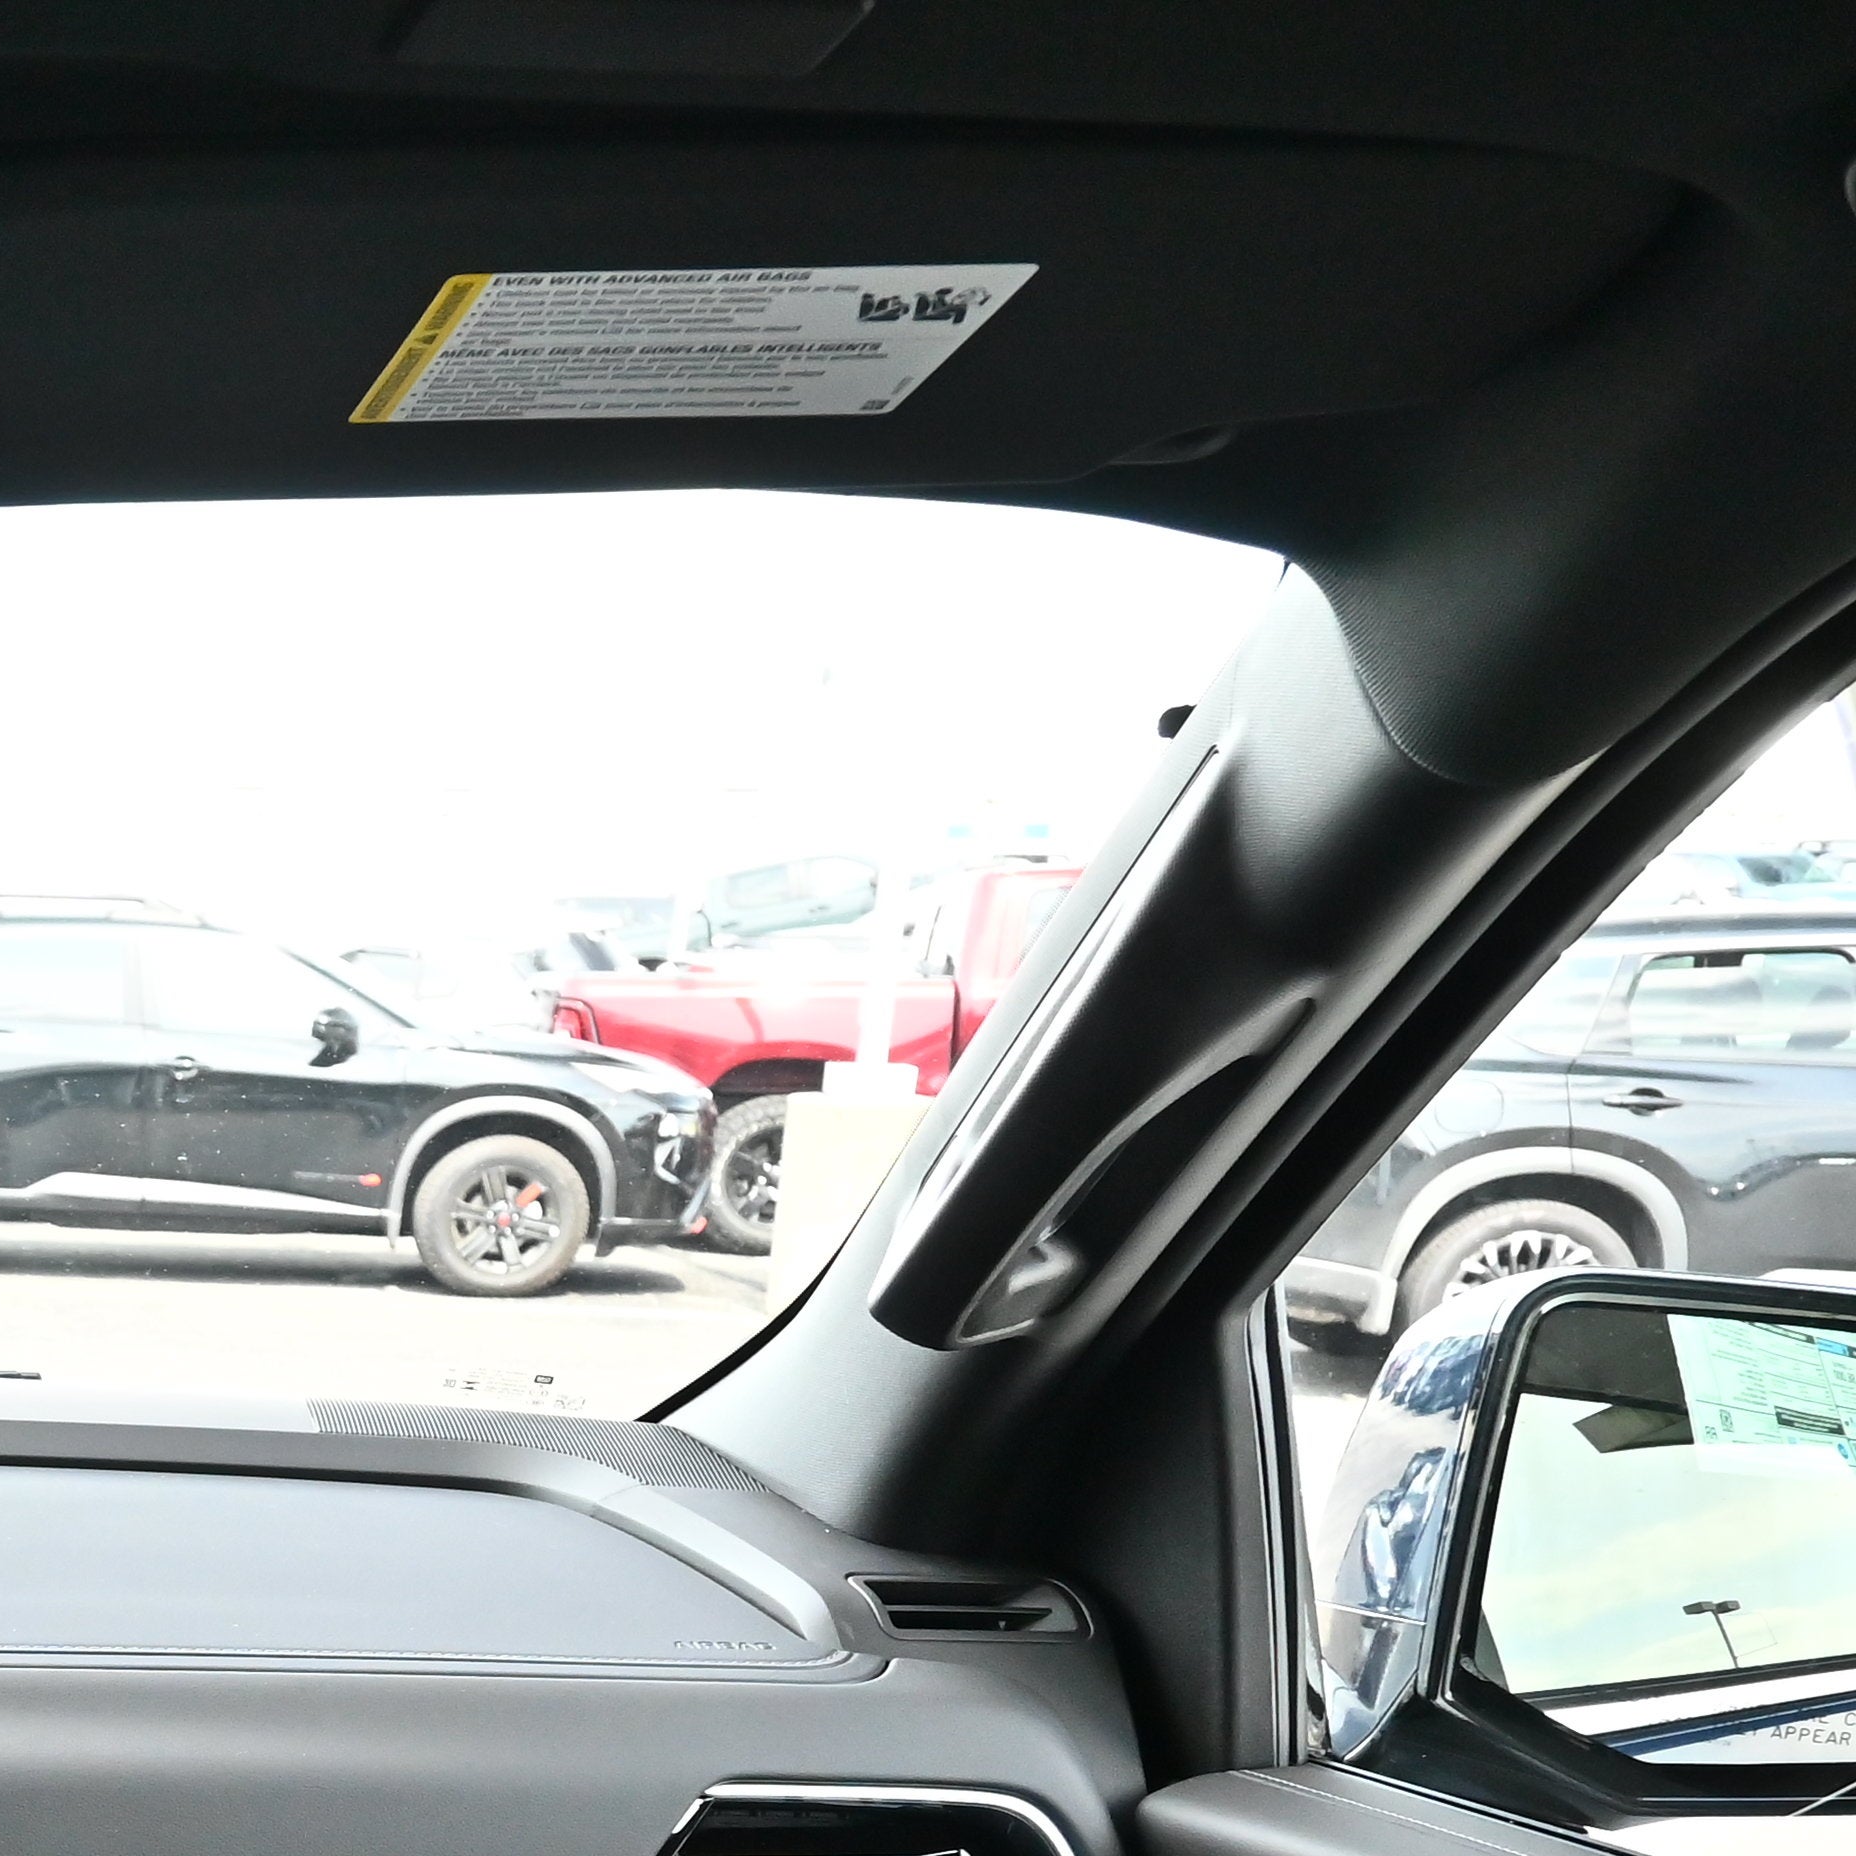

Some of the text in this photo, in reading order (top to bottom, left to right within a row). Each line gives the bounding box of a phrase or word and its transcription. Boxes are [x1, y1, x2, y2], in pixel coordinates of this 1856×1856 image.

[493, 276, 544, 286] EVEN
[549, 275, 600, 285] WITH
[602, 273, 713, 284] ADVANCED
[716, 273, 753, 282] AIR
[1770, 1725, 1852, 1747] APPEAR
